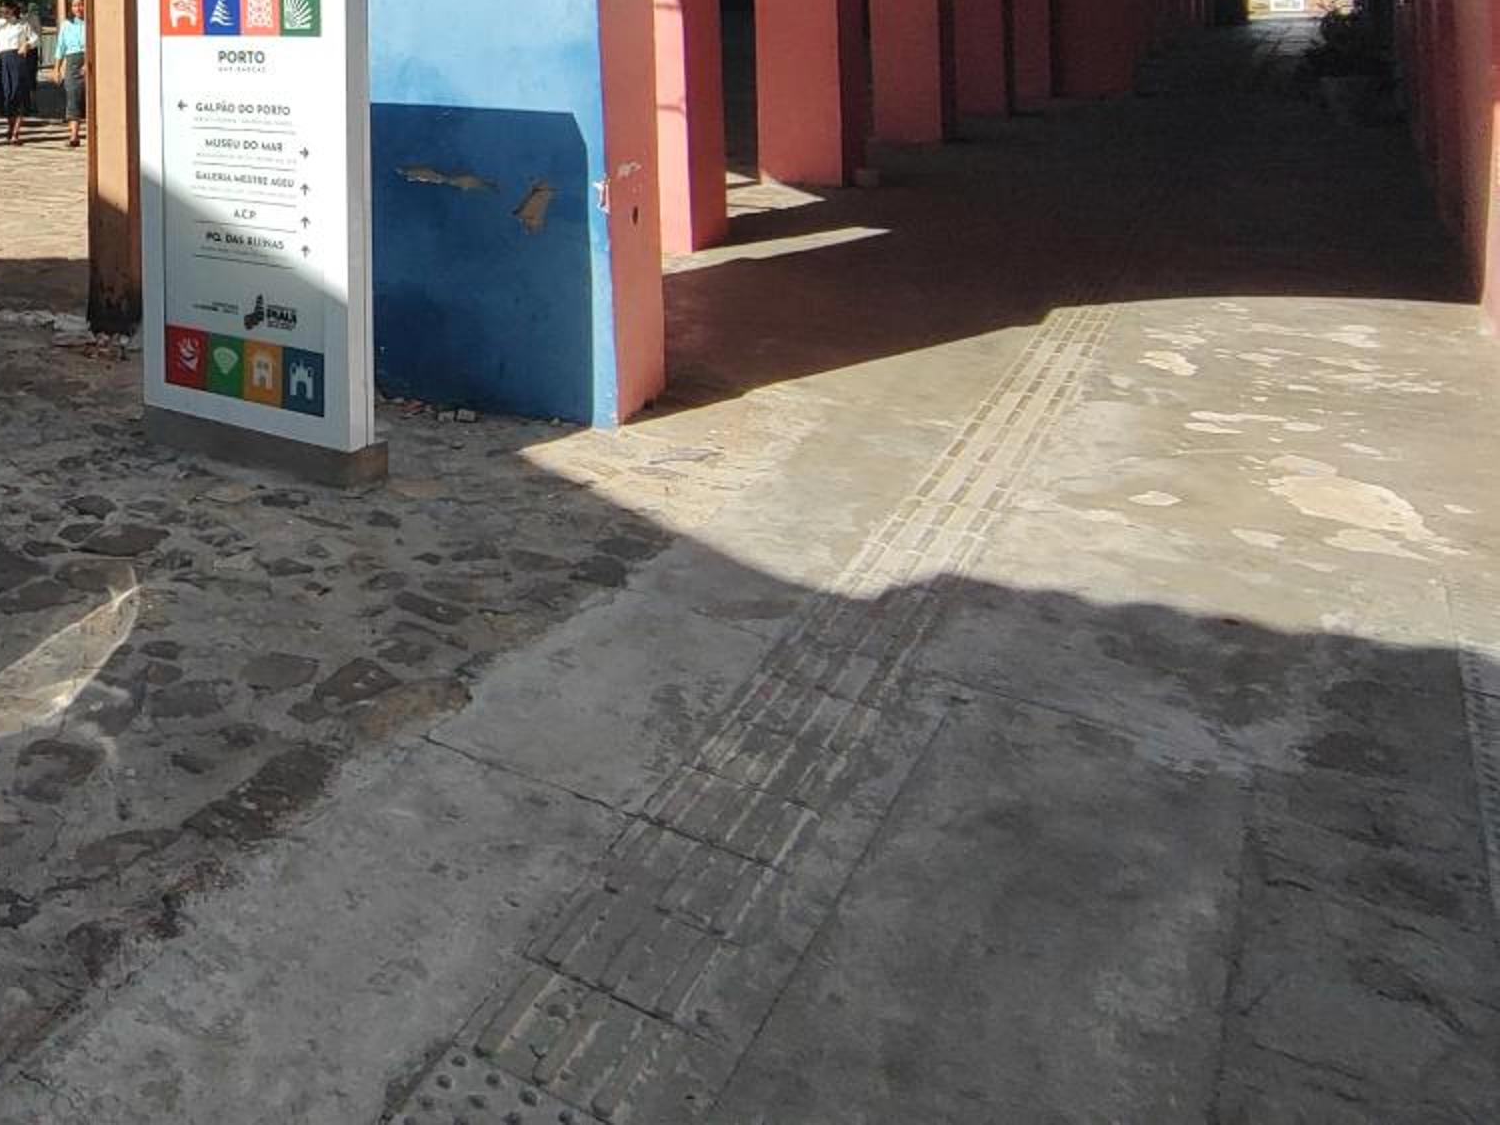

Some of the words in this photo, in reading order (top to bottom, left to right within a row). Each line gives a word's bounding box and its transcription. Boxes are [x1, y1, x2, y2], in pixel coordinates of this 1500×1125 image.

[218, 50, 265, 64] PORTO
[237, 104, 255, 114] DO
[257, 105, 291, 116] PORTO
[205, 138, 240, 150] MUSEU
[243, 140, 258, 150] DO
[261, 141, 283, 152] MAR
[195, 170, 231, 182] GALERIA
[233, 174, 268, 186] MESTRE
[225, 234, 244, 245] DAS
